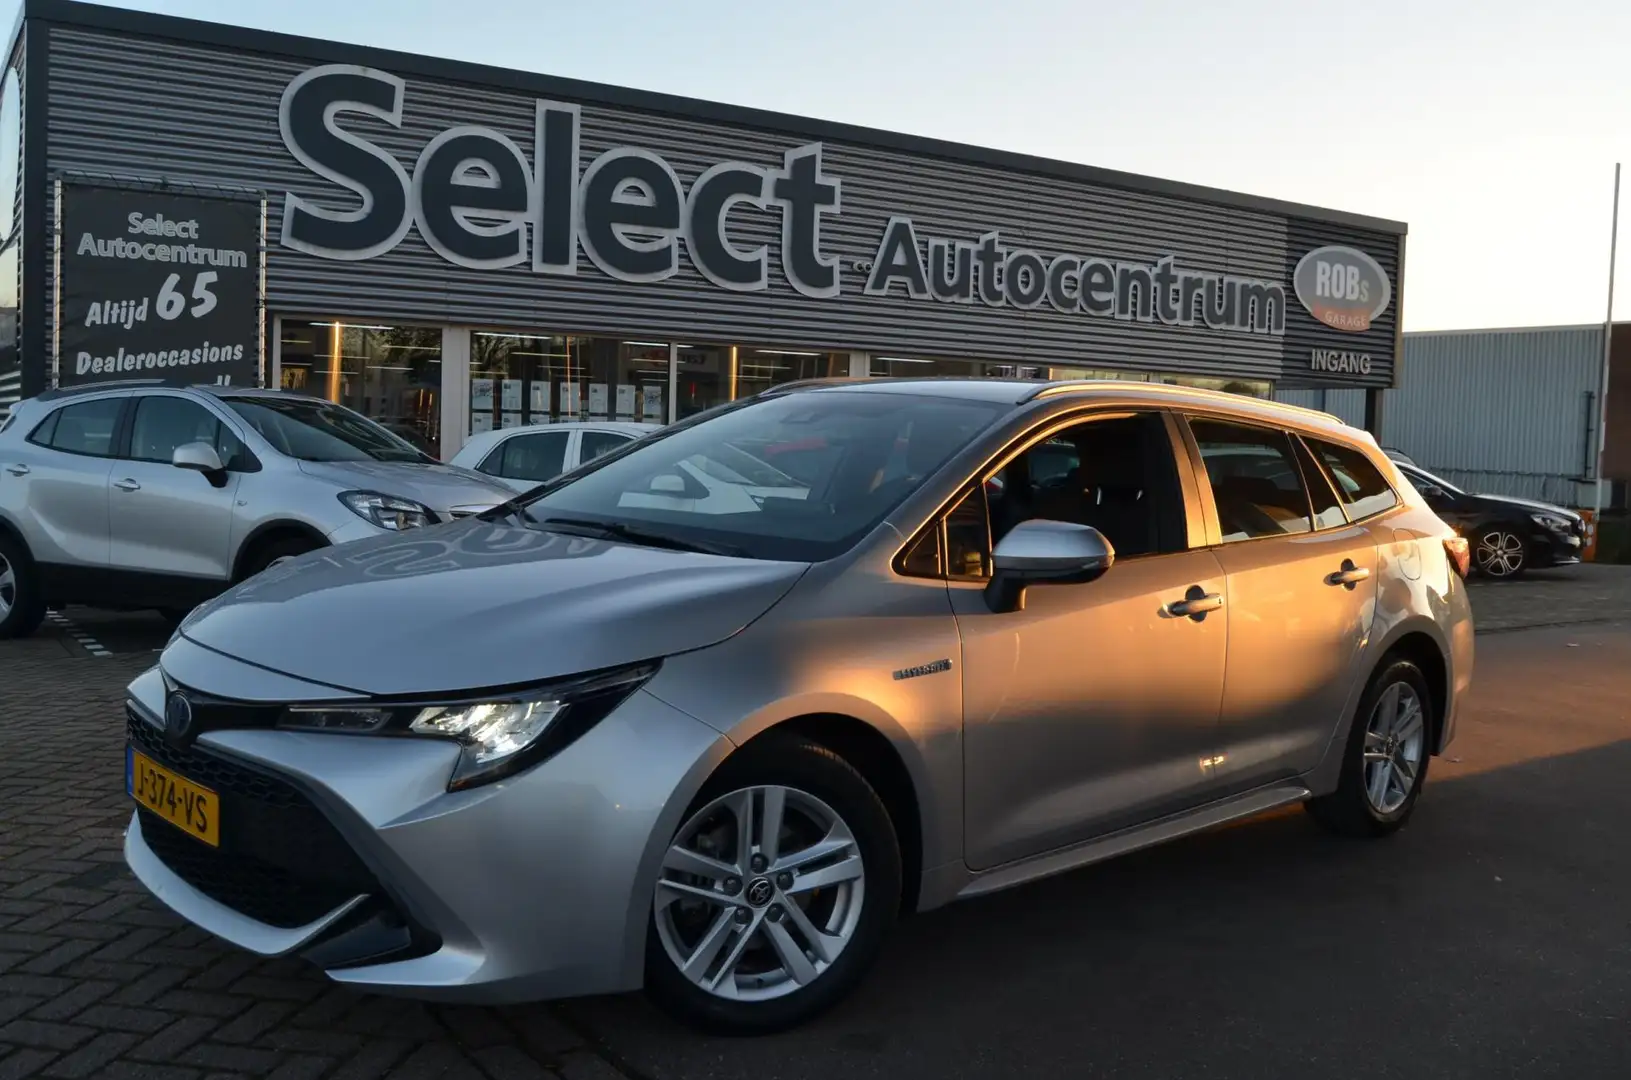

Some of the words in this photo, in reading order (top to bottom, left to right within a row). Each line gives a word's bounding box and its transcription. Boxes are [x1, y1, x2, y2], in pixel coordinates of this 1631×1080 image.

[279, 63, 841, 298] Select
[864, 216, 1286, 335] Autocentrum
[128, 212, 199, 239] Select
[77, 232, 247, 267] Autocentrum
[85, 297, 149, 330] Altijd
[155, 271, 218, 320] 65
[1325, 311, 1368, 328] GARAGE
[76, 341, 243, 375] Dealeroccasions
[1311, 348, 1371, 374] INGANG
[138, 761, 207, 833] J-374-VS
